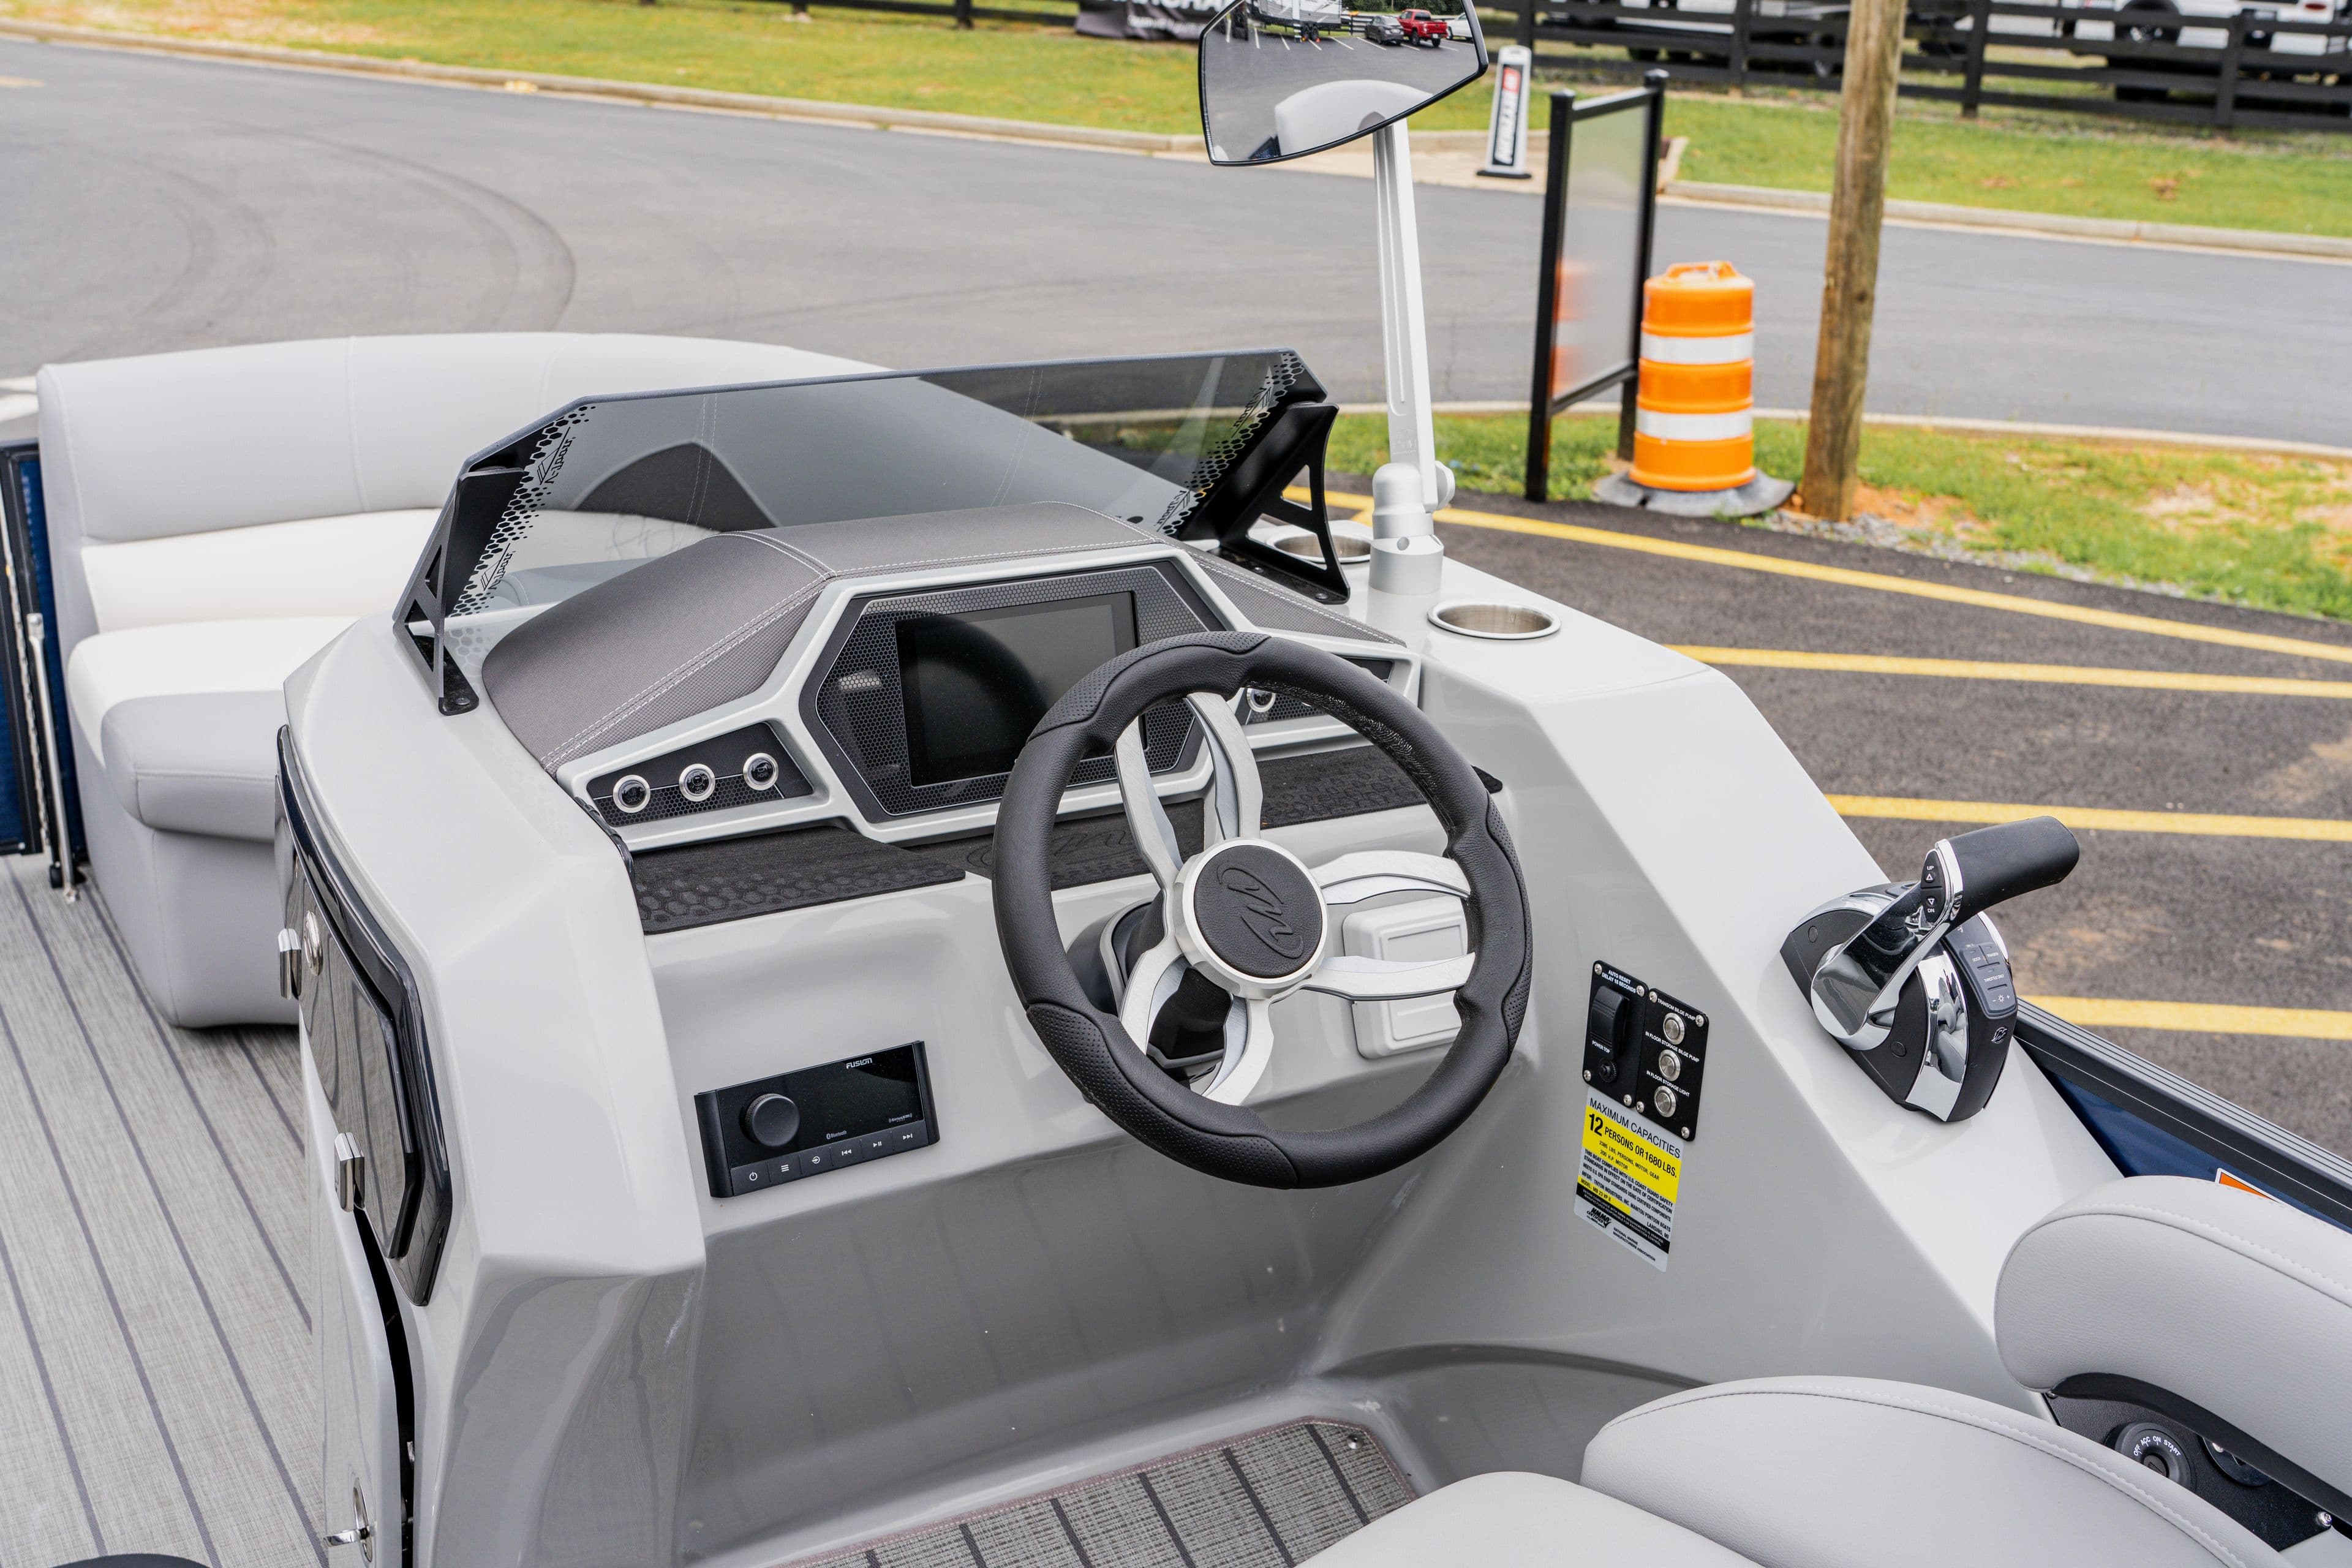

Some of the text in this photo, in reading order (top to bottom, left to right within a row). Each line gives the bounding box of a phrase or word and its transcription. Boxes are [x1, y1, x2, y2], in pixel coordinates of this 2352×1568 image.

[1602, 972, 1613, 981] DELAY
[1608, 970, 1619, 979] AUTO
[1657, 998, 1674, 1010] TRANSOM
[1674, 1007, 1684, 1016] BILGE
[1649, 1033, 1661, 1042] FLOOR
[1661, 1039, 1678, 1052] STORAGE
[1678, 1049, 1688, 1057] BILGE
[1650, 1072, 1662, 1082] FLOOR
[1662, 1079, 1678, 1091] STORAGE
[1589, 1114, 1603, 1136] 12
[1590, 1098, 1679, 1158] MAXIMUM CAPACITIES
[1605, 1127, 1676, 1177] PERSONS OR 1680 LBS.
[1615, 1159, 1627, 1170] MOTOR
[1584, 1155, 1603, 1170] STANDARDS
[1608, 1170, 1619, 1180] EFFECT
[1632, 1186, 1642, 1194] DATE
[1647, 1195, 1672, 1213] CERTIFICATION
[1649, 1171, 1659, 1180] GEAR
[1635, 1180, 1646, 1190] COAST
[1647, 1188, 1659, 1198] GUARD
[1659, 1196, 1673, 1207] SAFETY
[1630, 1203, 1645, 1215] MANITOU
[1645, 1212, 1659, 1224] PONTOON
[1660, 1222, 1670, 1232] BOATS
[2141, 1436, 2150, 1446] ACC
[2163, 1440, 2181, 1456] START
